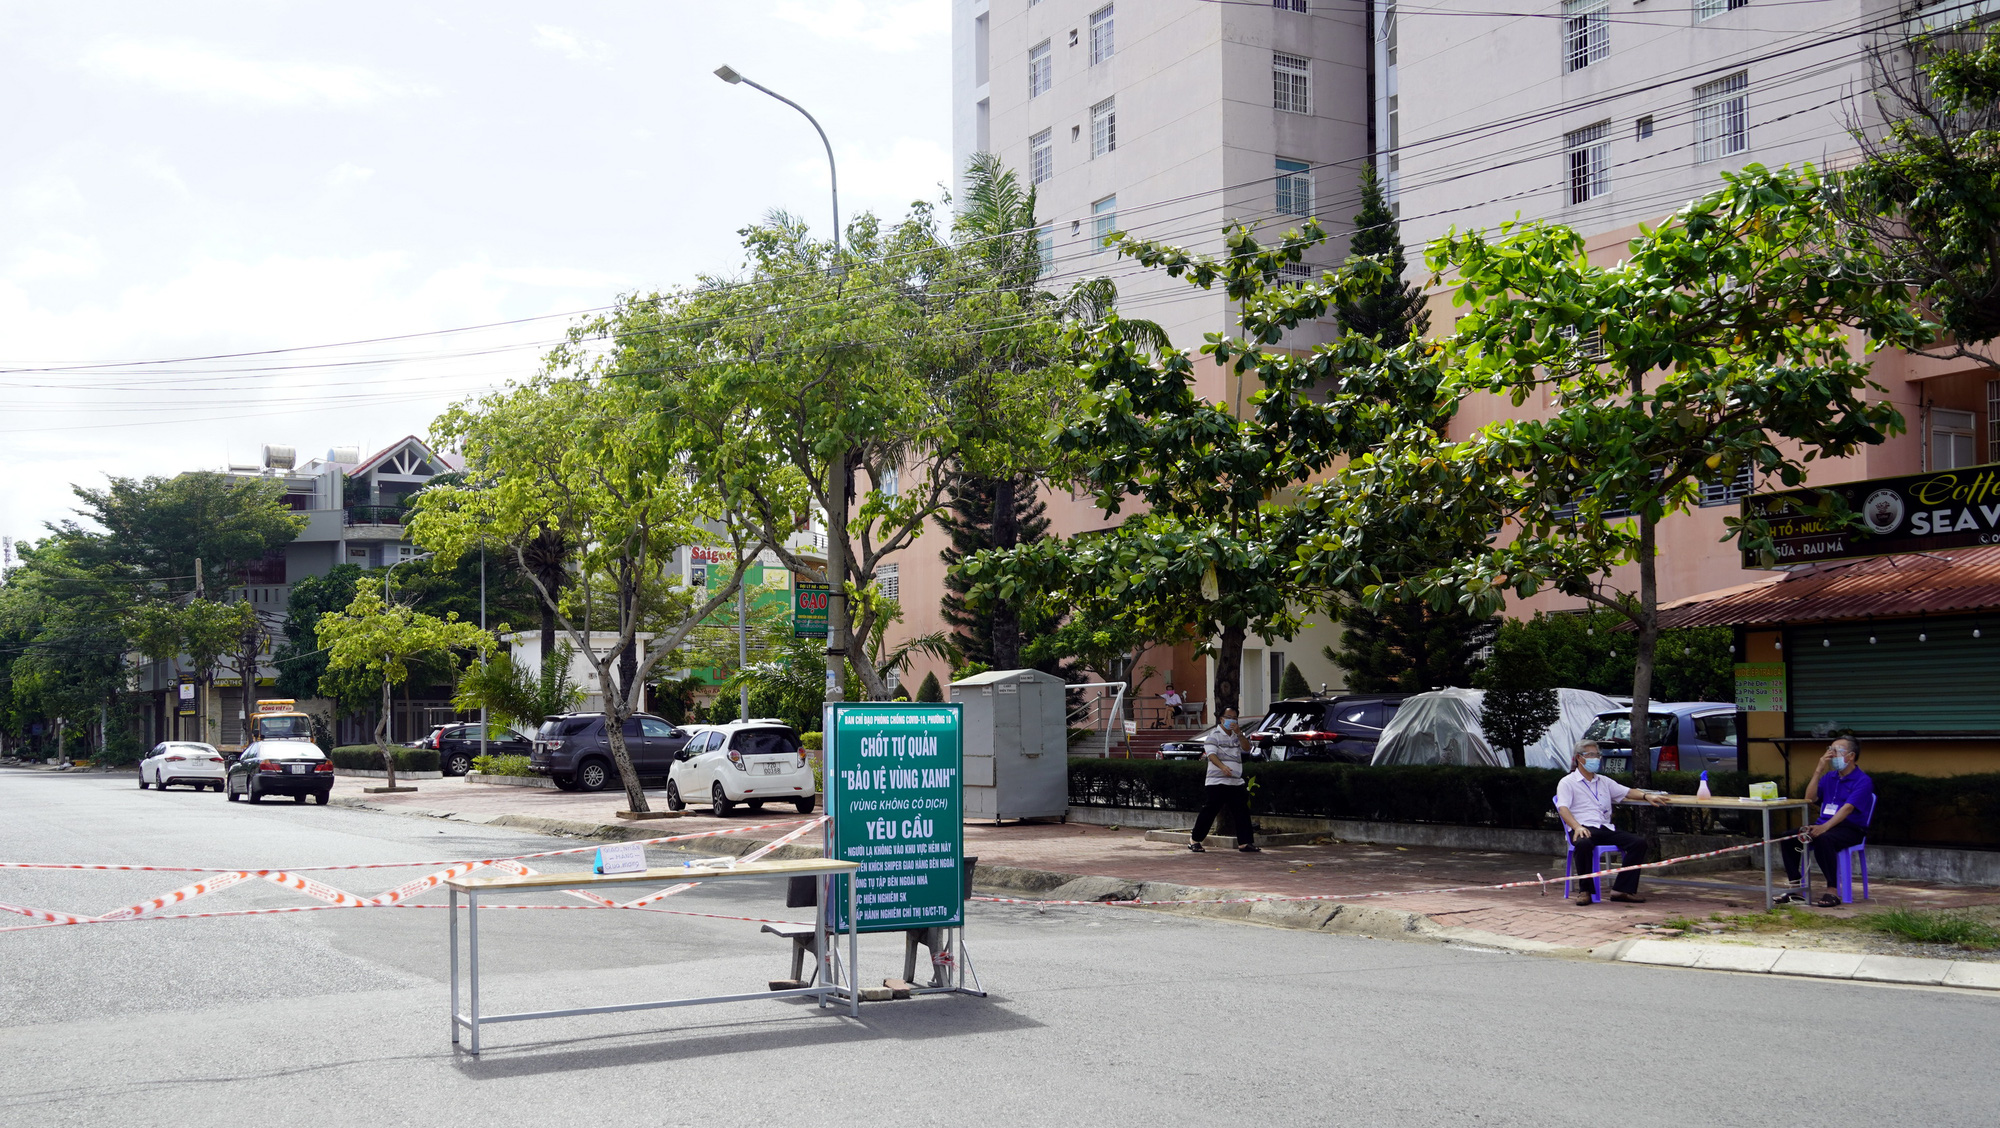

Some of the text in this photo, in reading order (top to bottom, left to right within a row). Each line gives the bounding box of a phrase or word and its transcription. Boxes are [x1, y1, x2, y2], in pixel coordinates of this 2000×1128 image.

[1780, 520, 1793, 535] TỐ
[1777, 543, 1795, 557] SỮA
[1803, 542, 1825, 554] RAU
[1827, 537, 1843, 552] MÁ
[799, 592, 827, 614] GẠO
[845, 716, 854, 724] BAN
[855, 713, 863, 724] CHỈ
[864, 716, 873, 726] ĐẠO
[874, 714, 889, 724] PHÒNG
[890, 713, 905, 724] CHỐNG
[928, 714, 945, 724] PHƯỜNG
[946, 716, 951, 724] 10
[861, 730, 937, 761] CHỐT TỰ QUẢN
[1610, 758, 1622, 767] 51G
[841, 763, 955, 794] "BẢO VỆ VÙNG XANH"
[850, 797, 948, 813] (VÙNG KHÔNG CÓ DỊCH)
[866, 813, 933, 840] YÊU CẦU
[848, 840, 951, 857] NGƯỜI LẠ KHÔNG VÀO KHU VỰC HẺM NÀY
[868, 860, 883, 871] KHÍCH
[884, 861, 902, 871] SHIPER
[903, 860, 914, 870] GIAO
[915, 858, 928, 869] HÀNG
[929, 857, 939, 868] BÊN
[940, 856, 954, 868] NGOÀI
[856, 873, 928, 889] ÔNG TỤ TẬP BÊN NGOÀI NHÀ
[863, 892, 876, 905] HIỆN
[878, 891, 898, 903] NGHIÊM
[900, 892, 907, 902] 5K
[864, 907, 879, 920] HÀNH
[880, 907, 901, 919] NGHIÊM
[903, 905, 911, 918] CHỈ
[913, 907, 921, 918] THỊ
[922, 906, 947, 916] 16/CT-TTg
